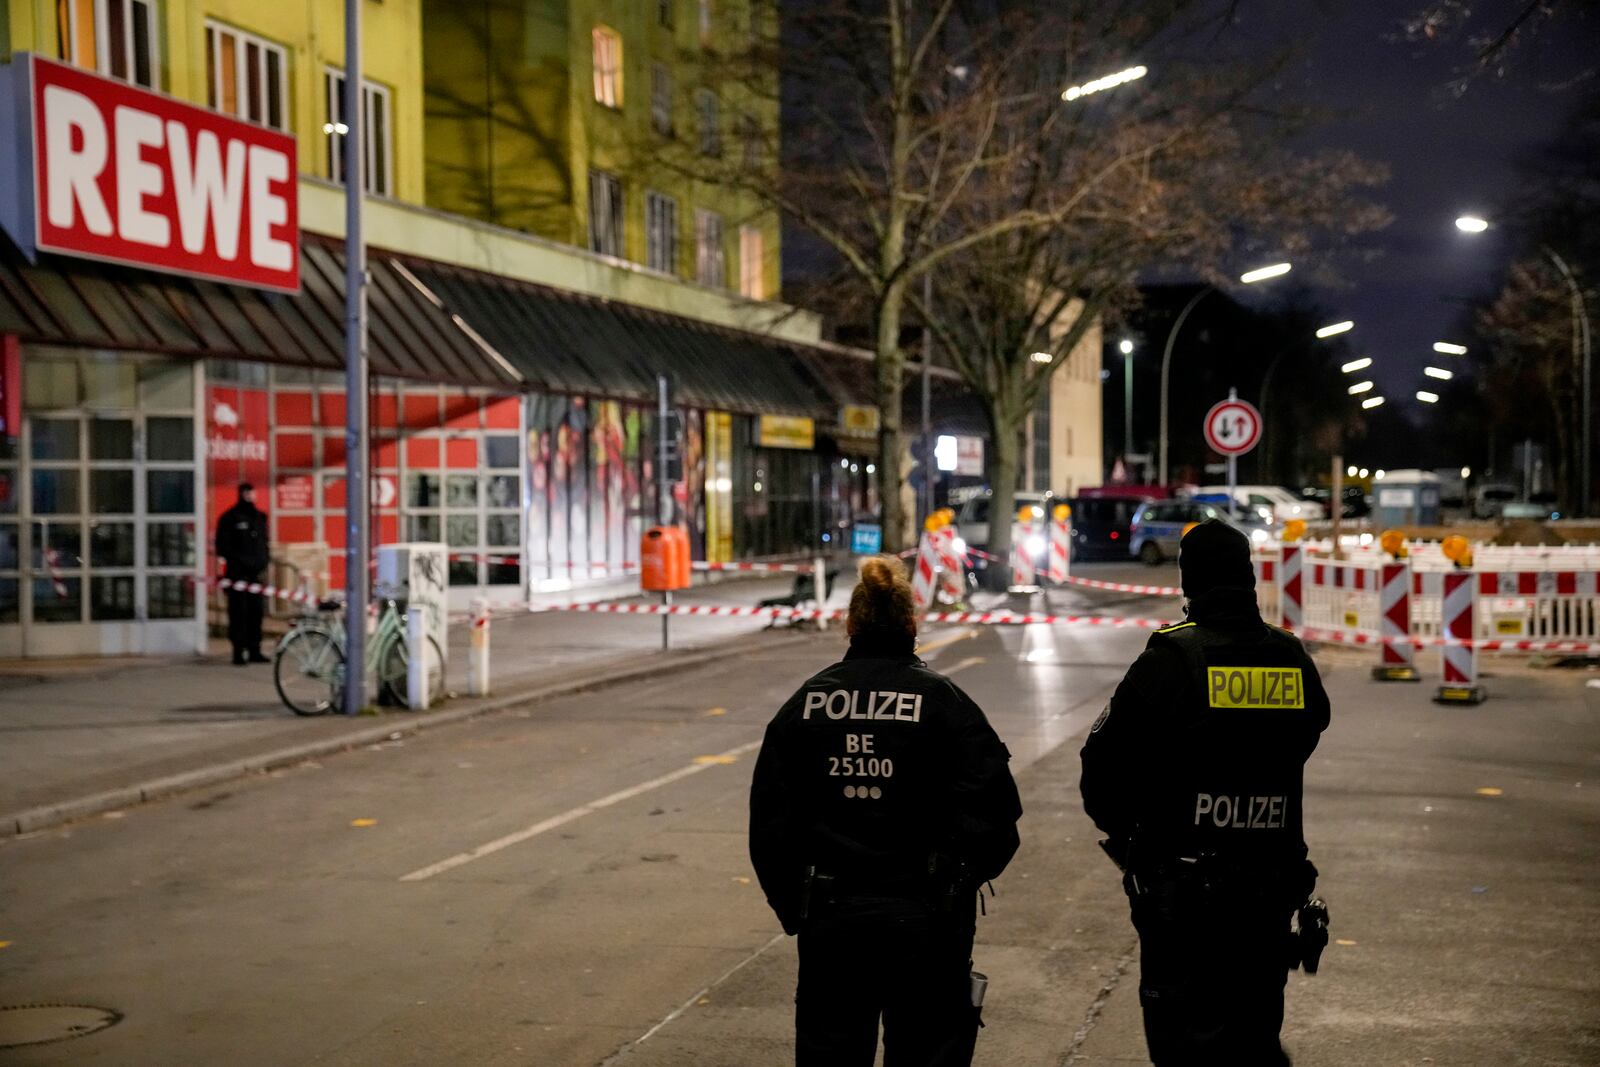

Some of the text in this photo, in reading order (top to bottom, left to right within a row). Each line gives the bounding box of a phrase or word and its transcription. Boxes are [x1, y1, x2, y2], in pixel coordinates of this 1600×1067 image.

[44, 85, 292, 271] REWE
[1211, 671, 1300, 705] POLIZEI
[803, 690, 922, 722] POLIZEI
[846, 734, 874, 753] BE
[829, 757, 893, 777] 25100
[1194, 793, 1287, 828] POLIZEI
